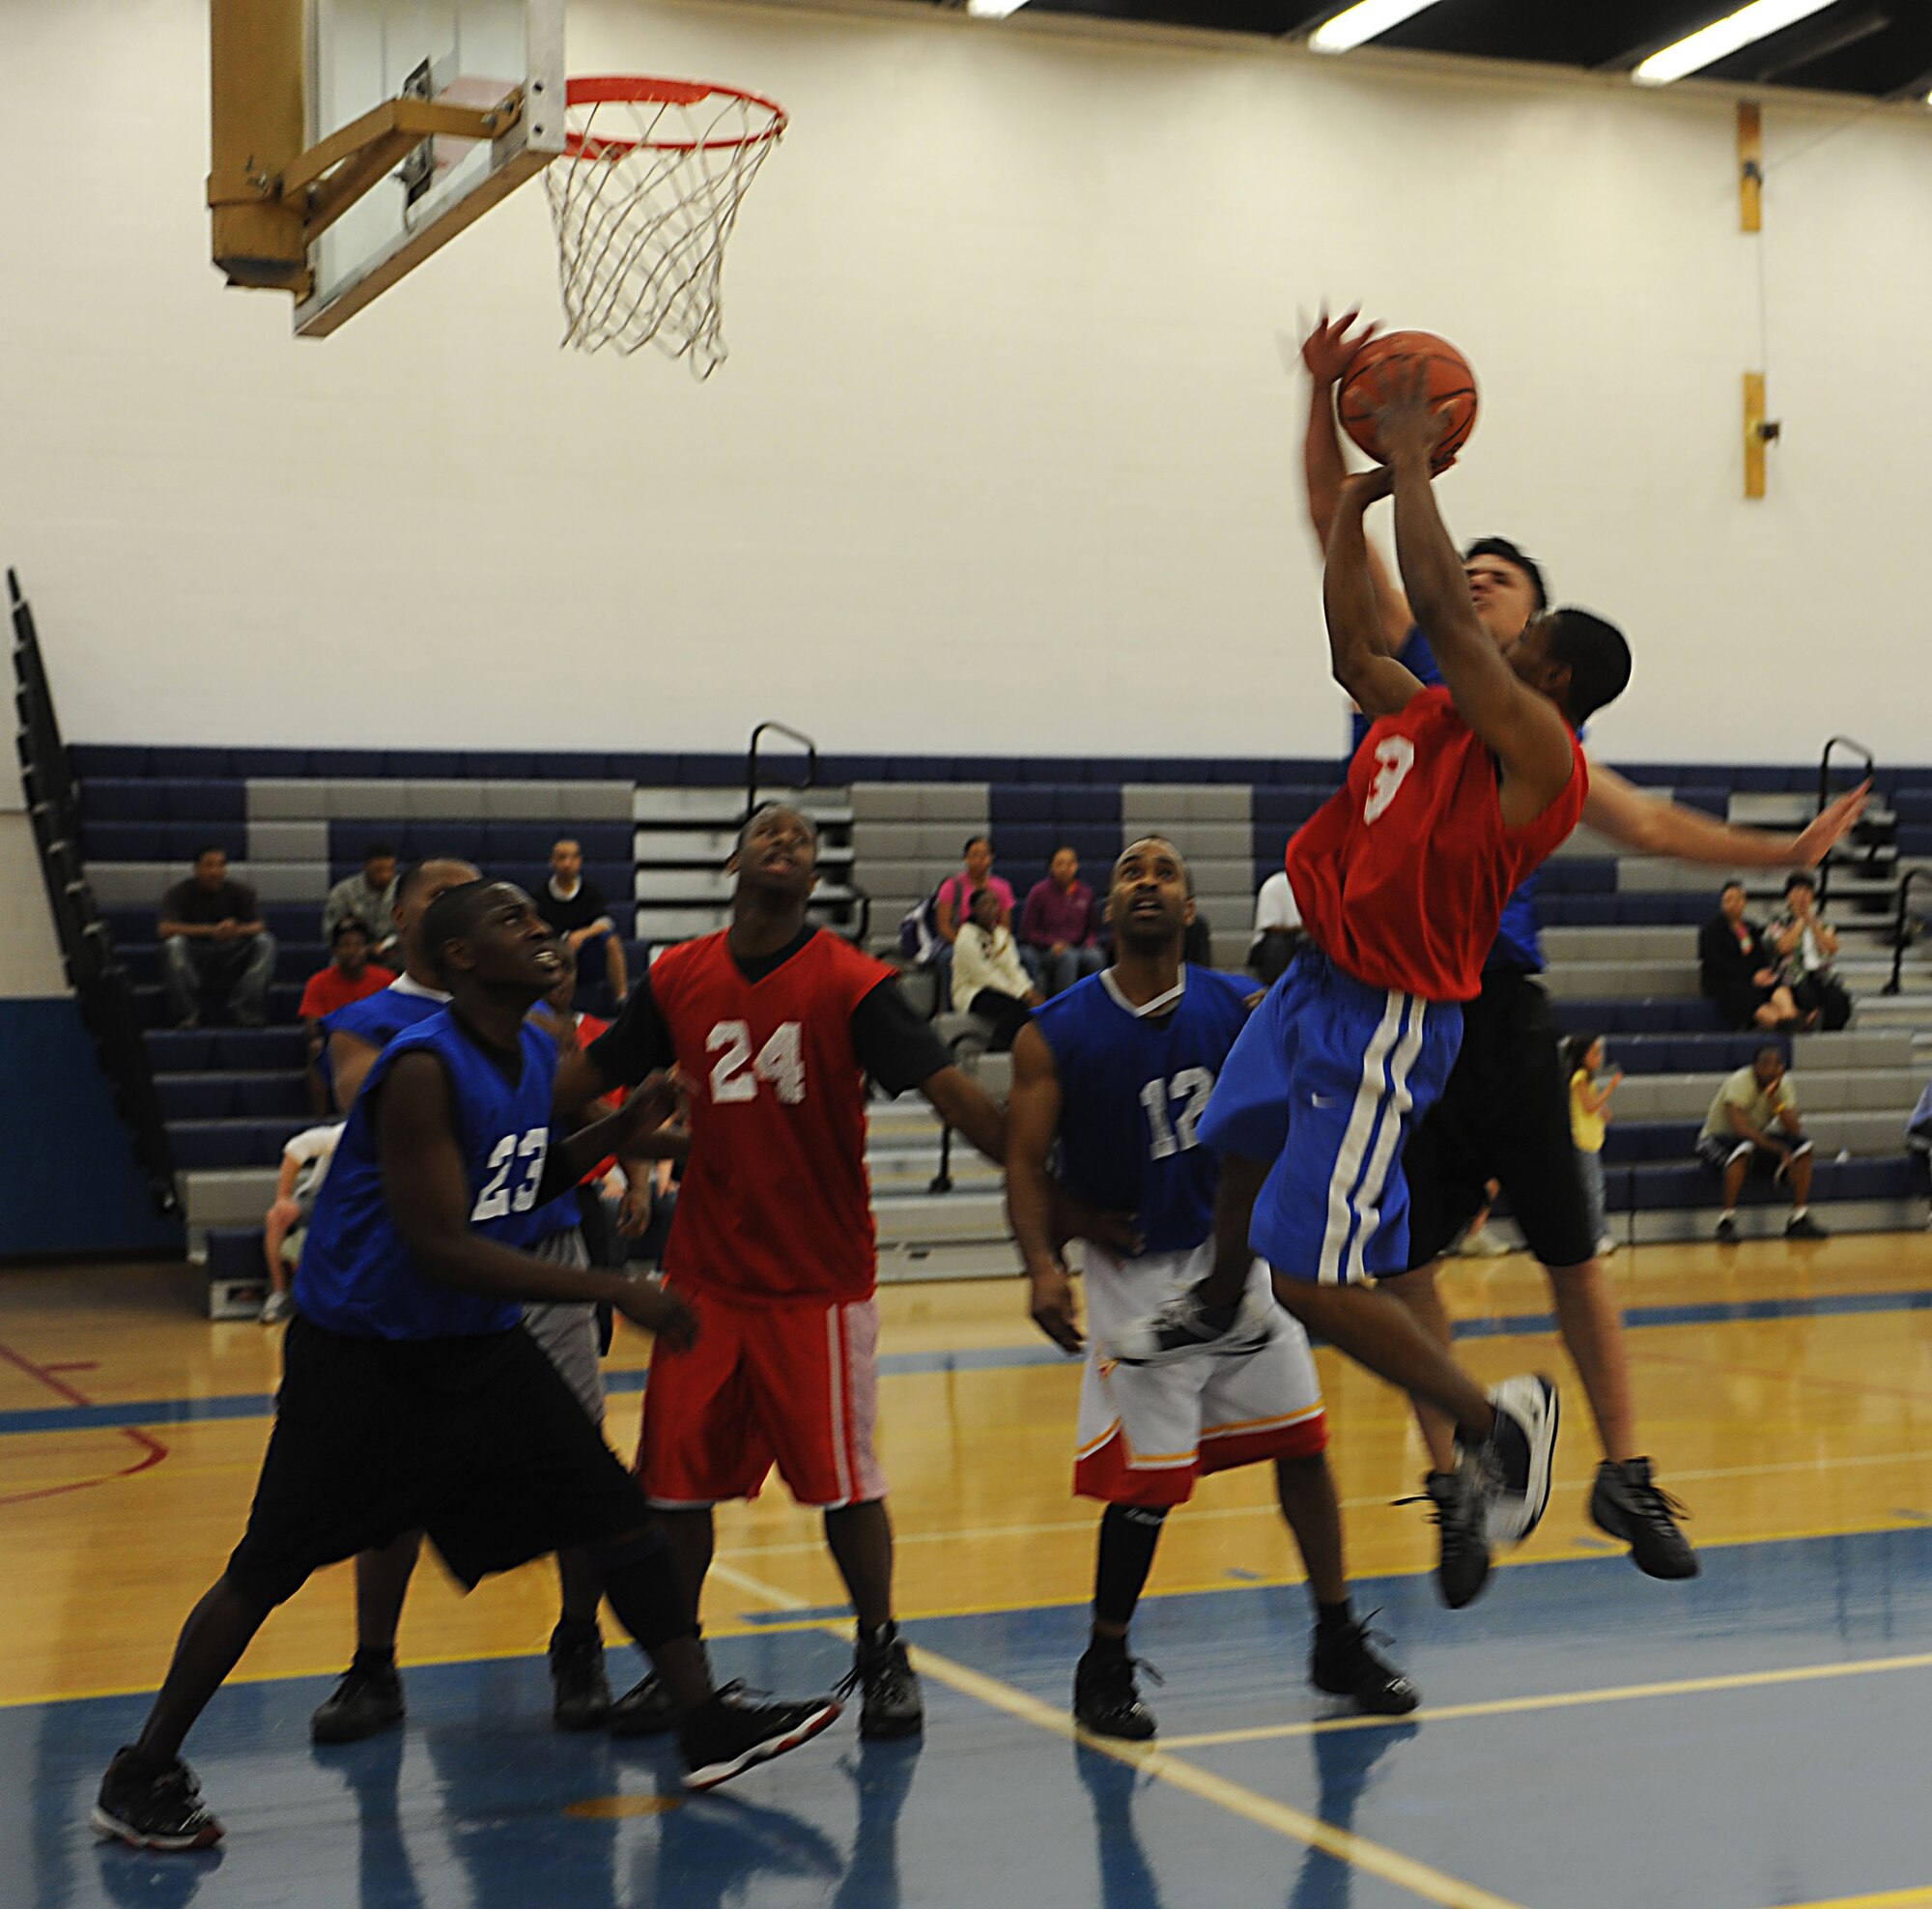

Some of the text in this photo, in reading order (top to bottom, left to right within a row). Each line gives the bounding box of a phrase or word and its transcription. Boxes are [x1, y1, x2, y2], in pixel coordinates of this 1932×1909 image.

[705, 1019, 806, 1104] 24
[1139, 1066, 1214, 1161] 12
[470, 1126, 549, 1222] 23
